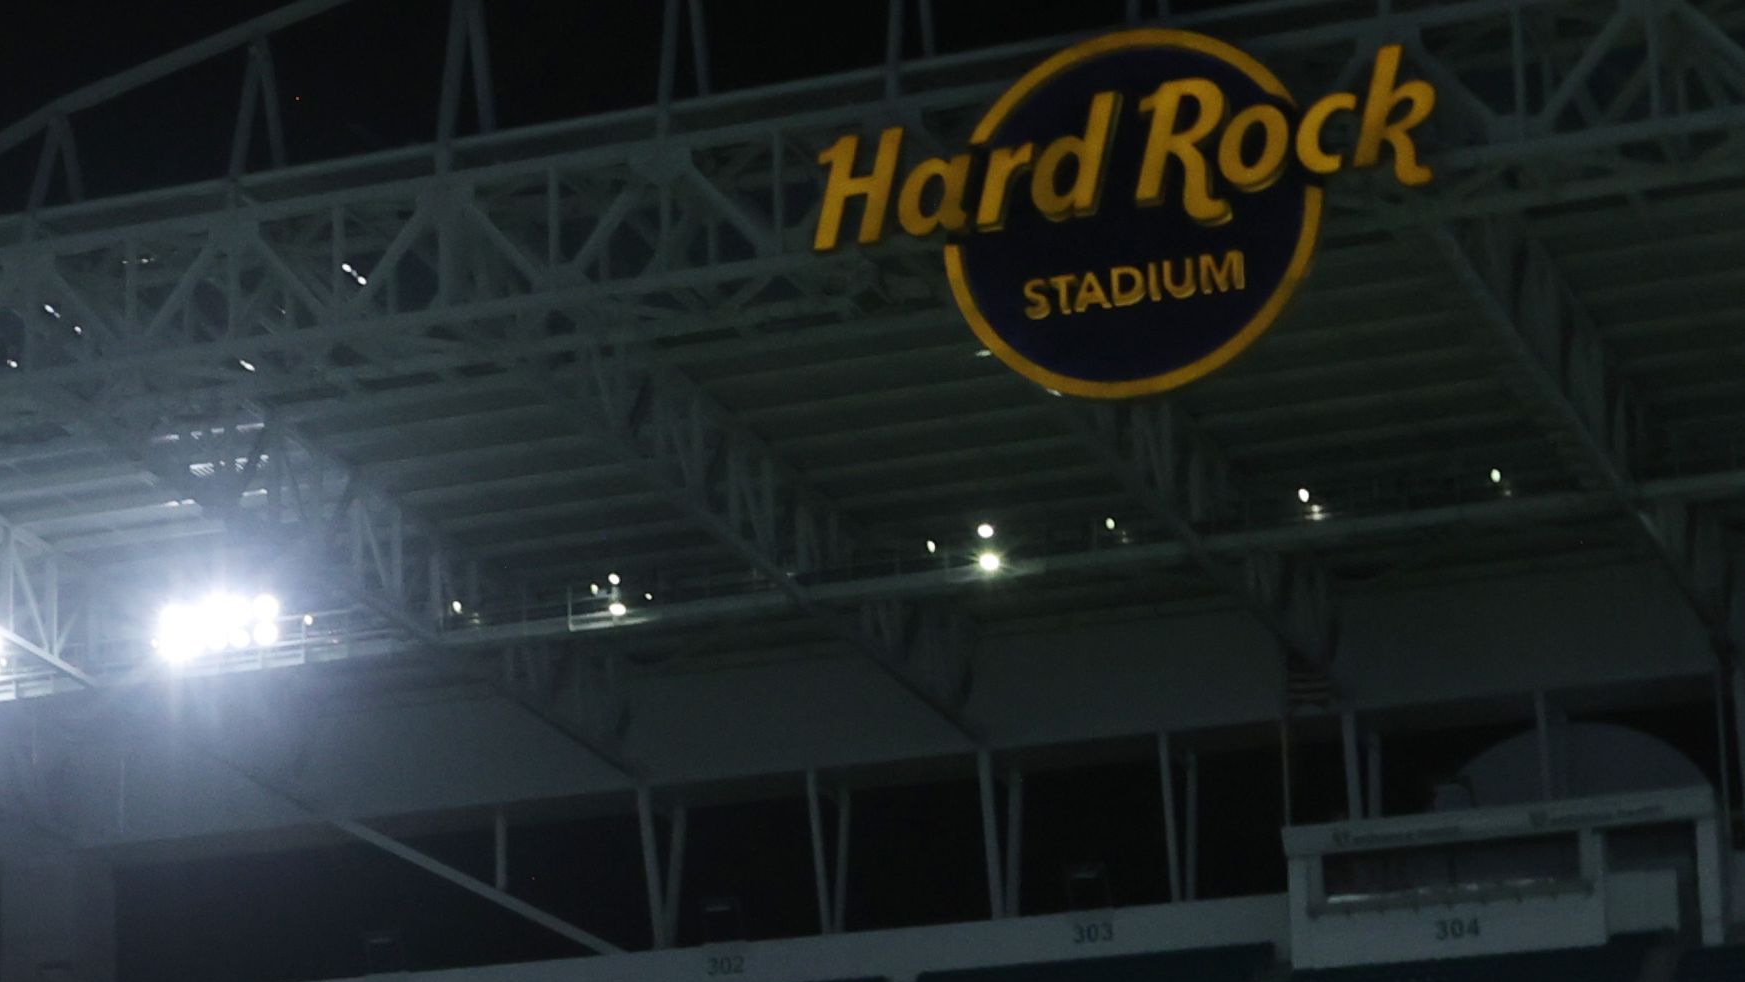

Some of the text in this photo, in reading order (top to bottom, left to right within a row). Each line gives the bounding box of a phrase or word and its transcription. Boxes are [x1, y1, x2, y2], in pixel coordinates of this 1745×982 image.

[813, 44, 1436, 250] Hard Rock
[1023, 250, 1246, 321] STADIUM
[1073, 923, 1114, 944] 303
[1435, 917, 1481, 941] 304
[707, 955, 745, 976] 302
